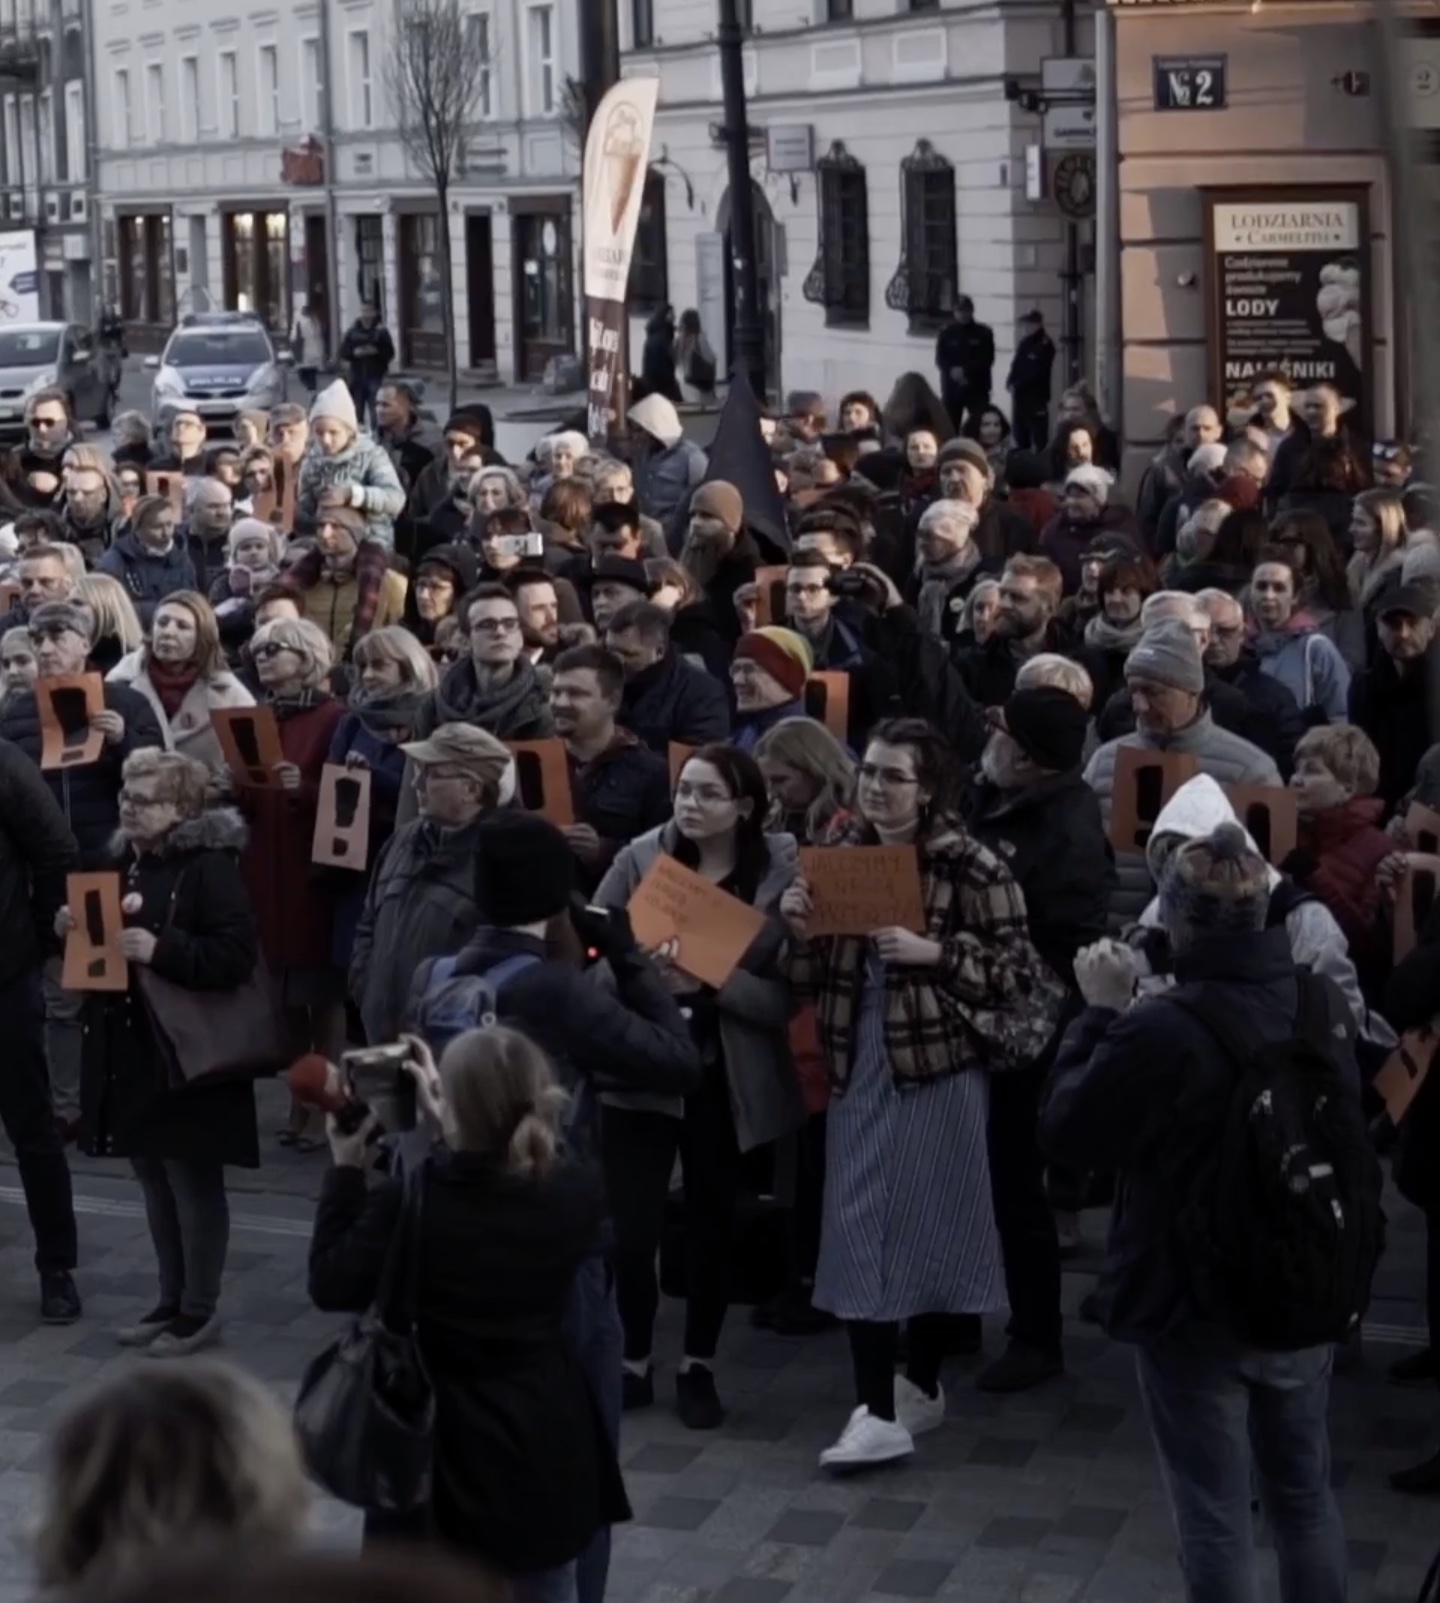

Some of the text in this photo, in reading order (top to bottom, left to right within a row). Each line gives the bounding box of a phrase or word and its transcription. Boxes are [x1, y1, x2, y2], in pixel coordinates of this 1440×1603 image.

[1195, 70, 1214, 105] 2
[1231, 213, 1345, 229] LODZIARNIA
[1225, 299, 1280, 316] LODY
